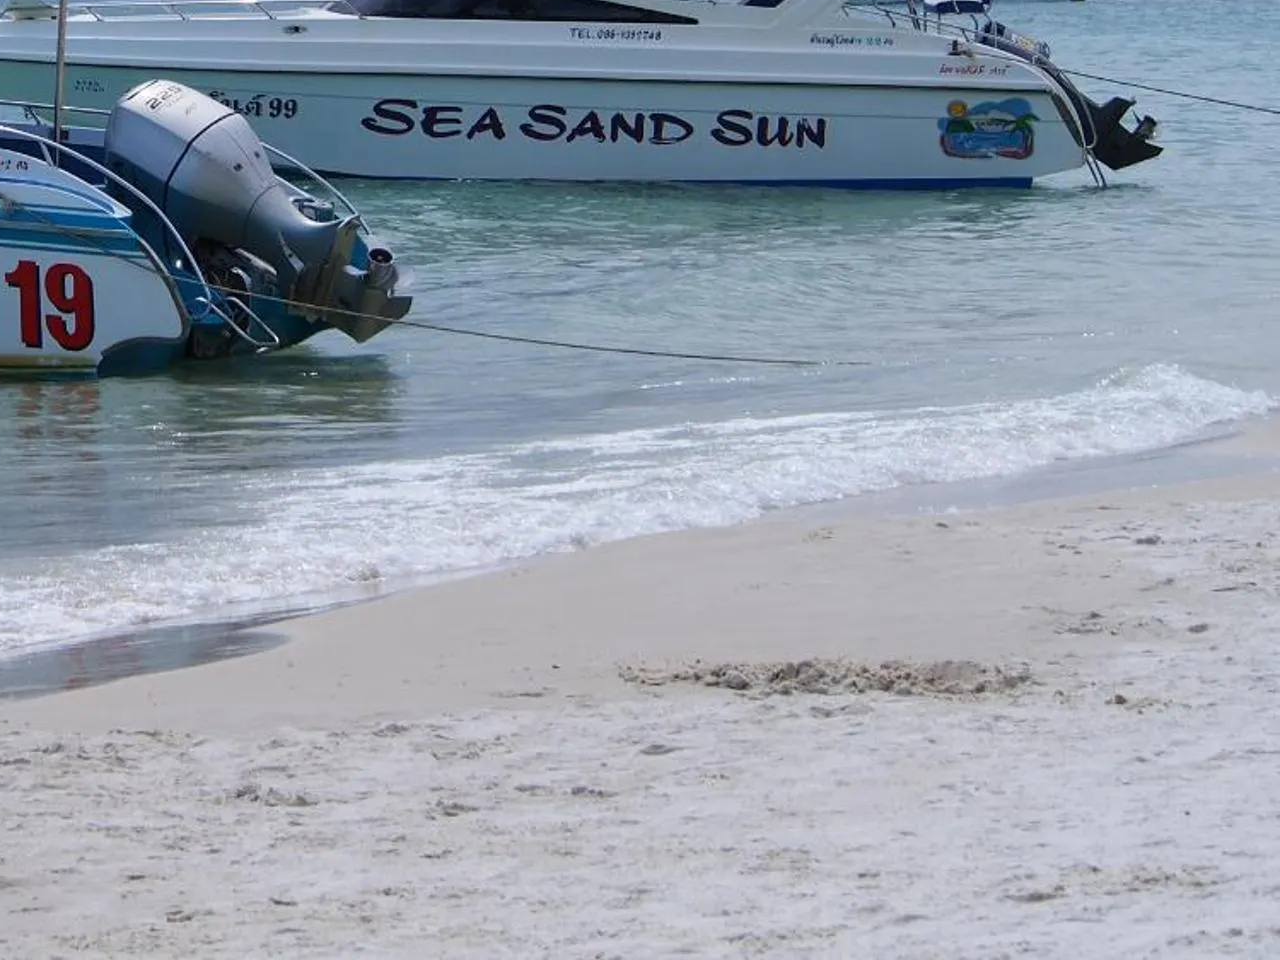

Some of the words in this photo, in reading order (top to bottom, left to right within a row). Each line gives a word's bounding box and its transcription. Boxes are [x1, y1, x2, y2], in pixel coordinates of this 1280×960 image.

[269, 97, 297, 118] 99
[361, 99, 506, 140] SEA
[519, 104, 694, 145] SAND
[710, 109, 826, 149] SUN
[5, 259, 96, 352] 19
